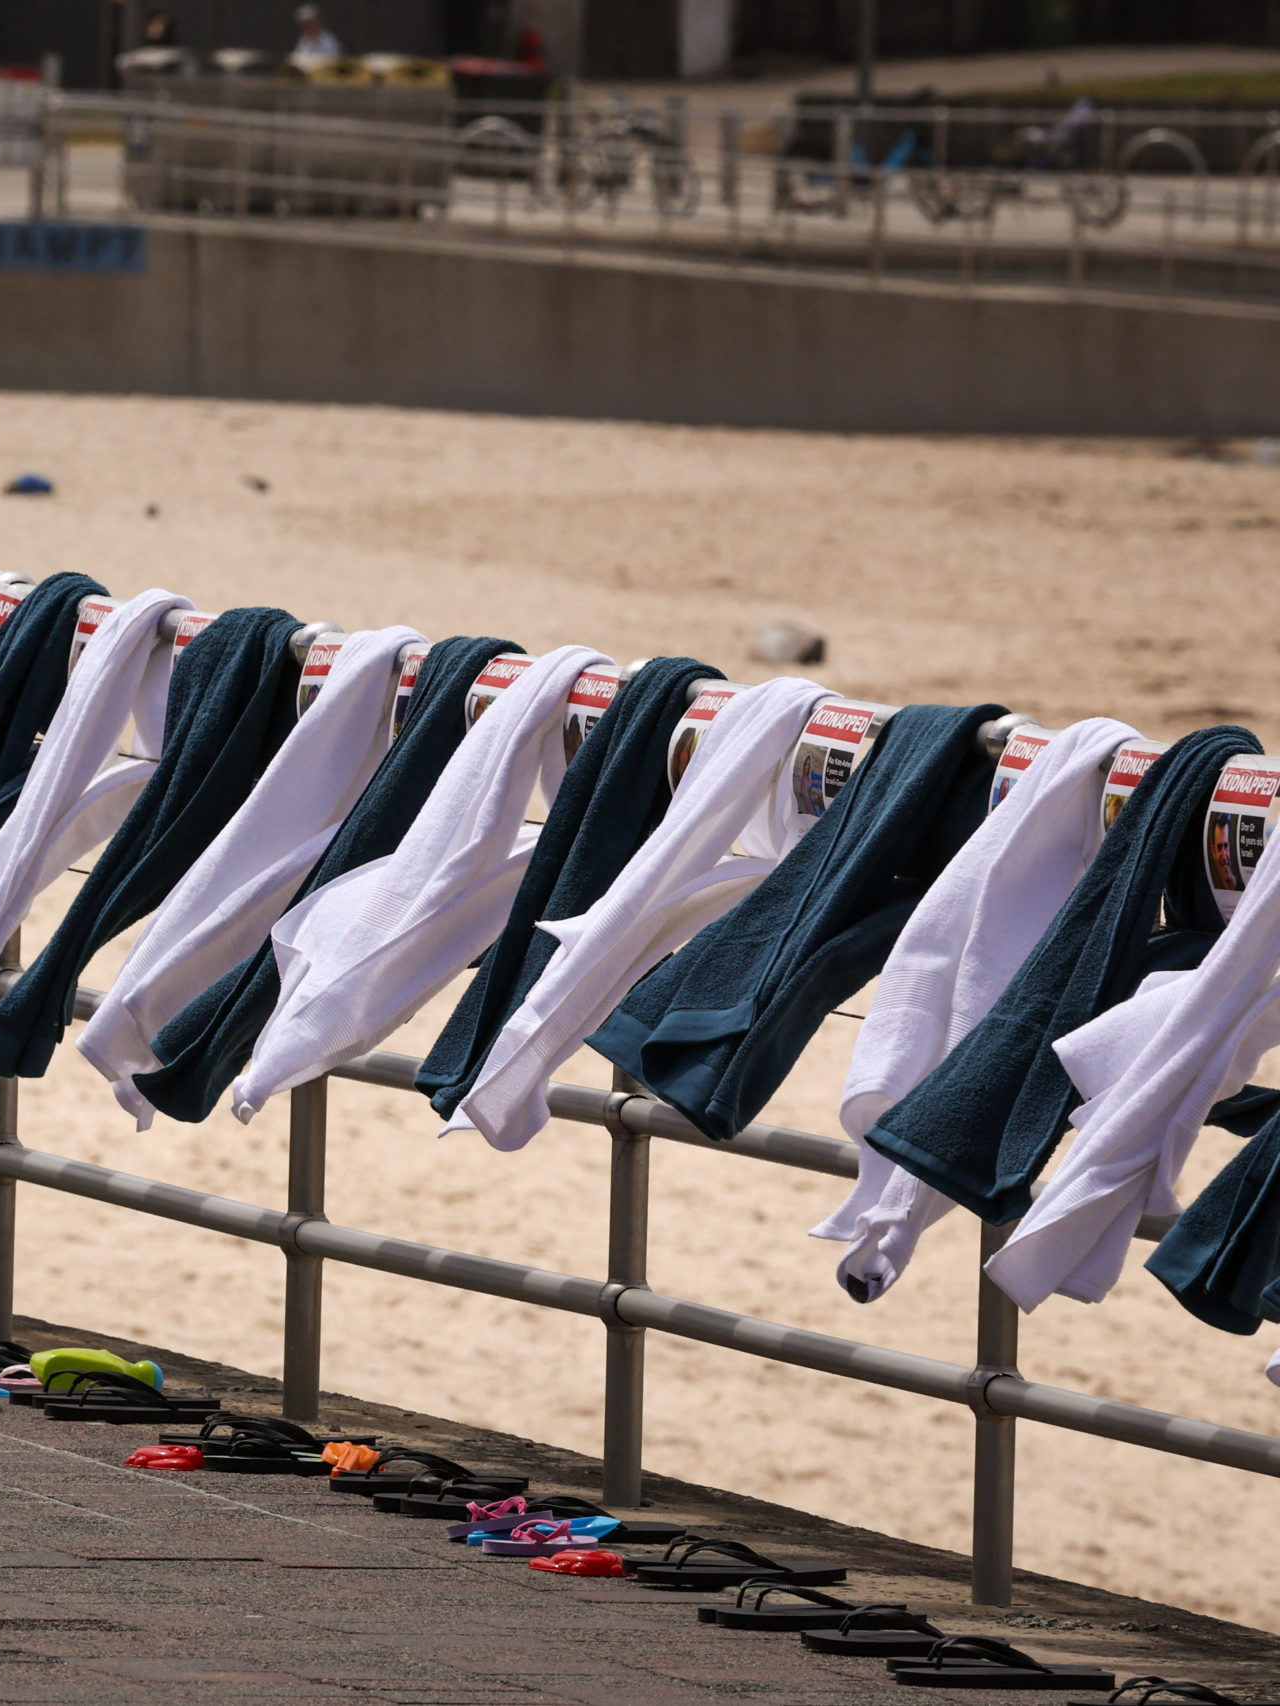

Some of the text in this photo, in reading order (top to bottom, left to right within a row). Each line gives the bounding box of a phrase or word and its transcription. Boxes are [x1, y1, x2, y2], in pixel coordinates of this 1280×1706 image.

[574, 678, 616, 699] KIDNAPPED
[812, 709, 869, 733] KIDNAPPED
[1219, 773, 1277, 795] KIDNAPPED
